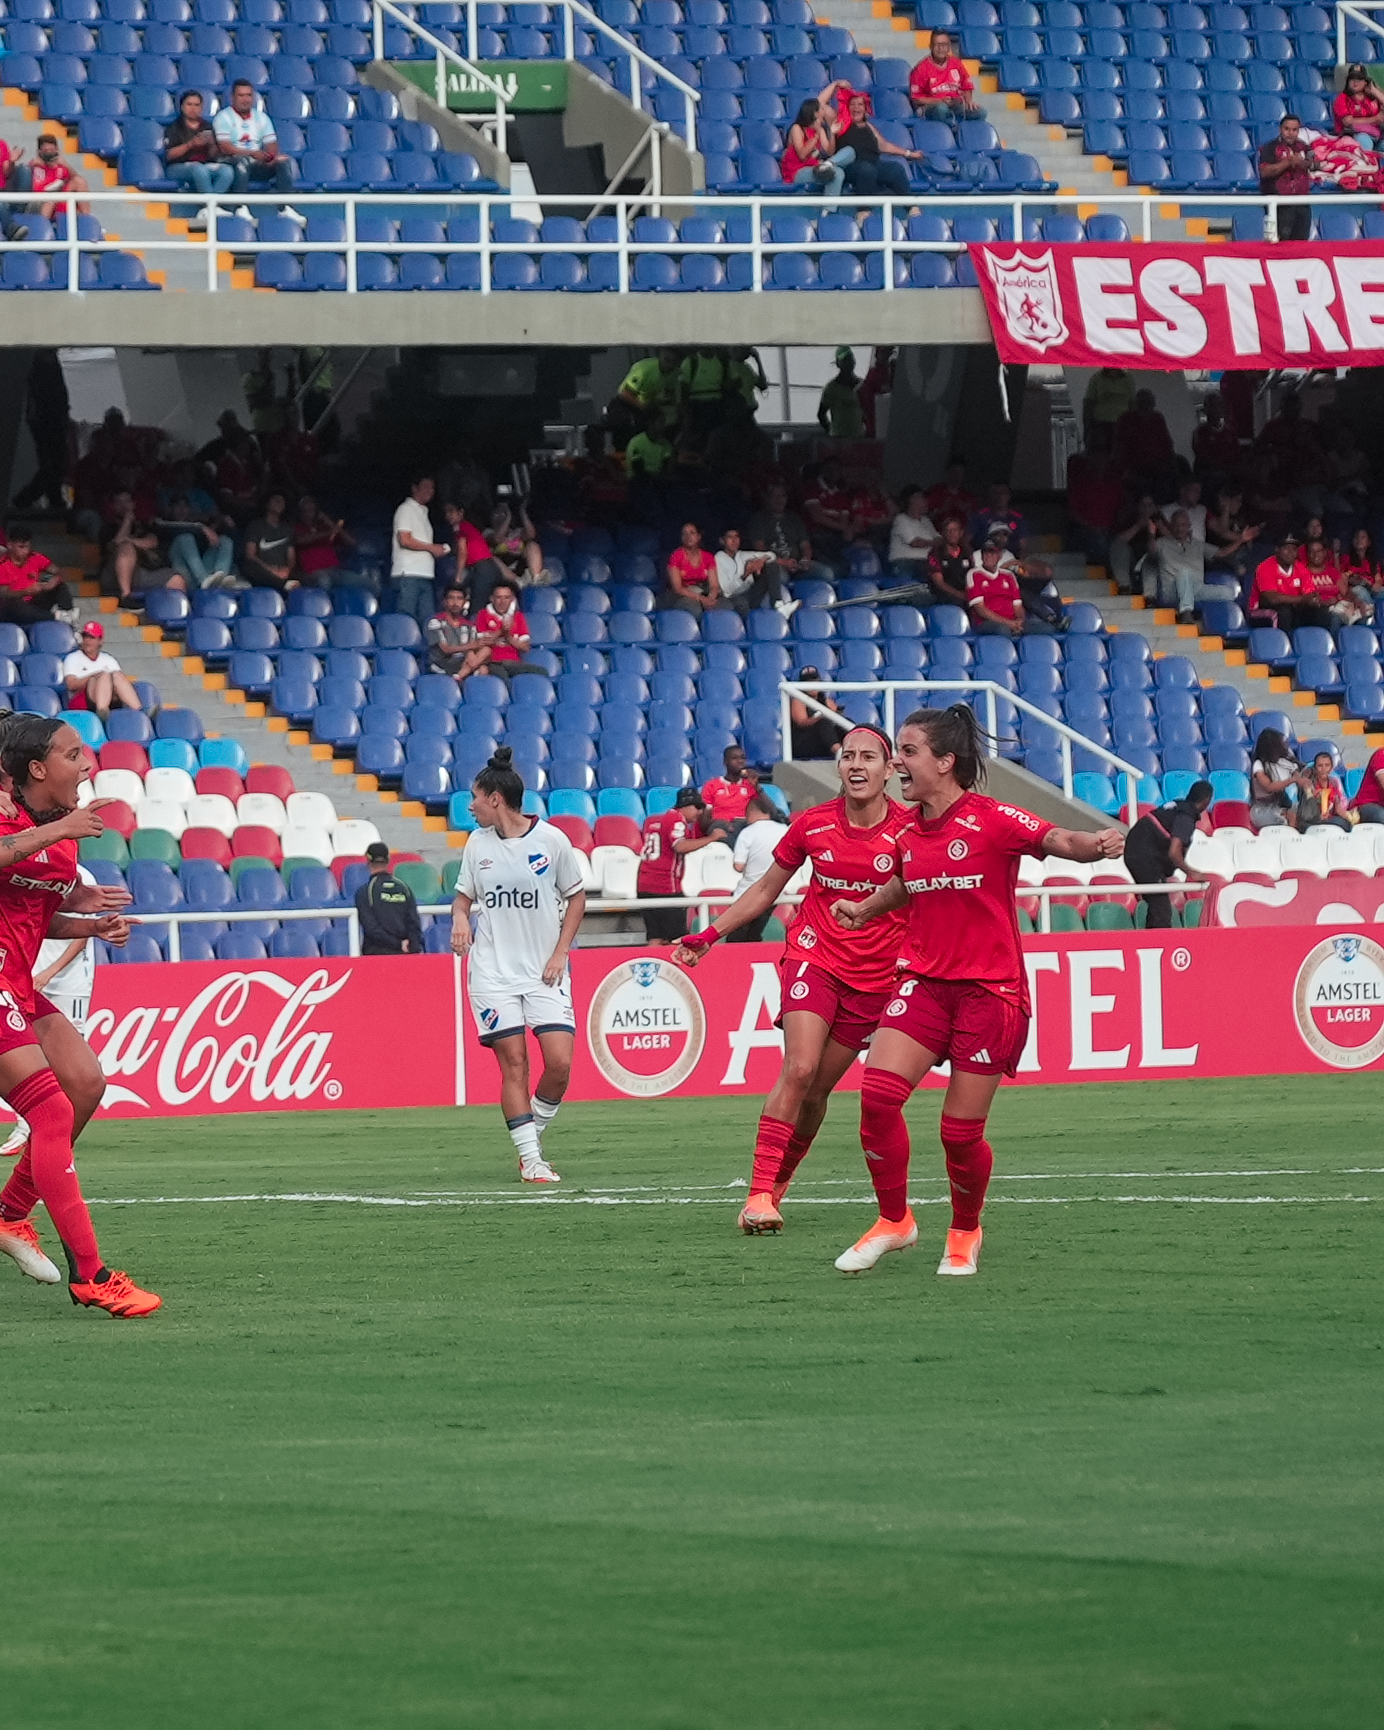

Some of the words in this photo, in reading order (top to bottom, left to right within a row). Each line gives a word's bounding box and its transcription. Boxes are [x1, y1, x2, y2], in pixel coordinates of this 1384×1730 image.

[1071, 255, 1384, 358] ESTRE
[484, 884, 539, 910] antel
[1316, 982, 1382, 1001] AMSTEL
[612, 1008, 682, 1028] AMSTEL
[1326, 1008, 1372, 1024] LAGER
[623, 1034, 671, 1050] LAGER
